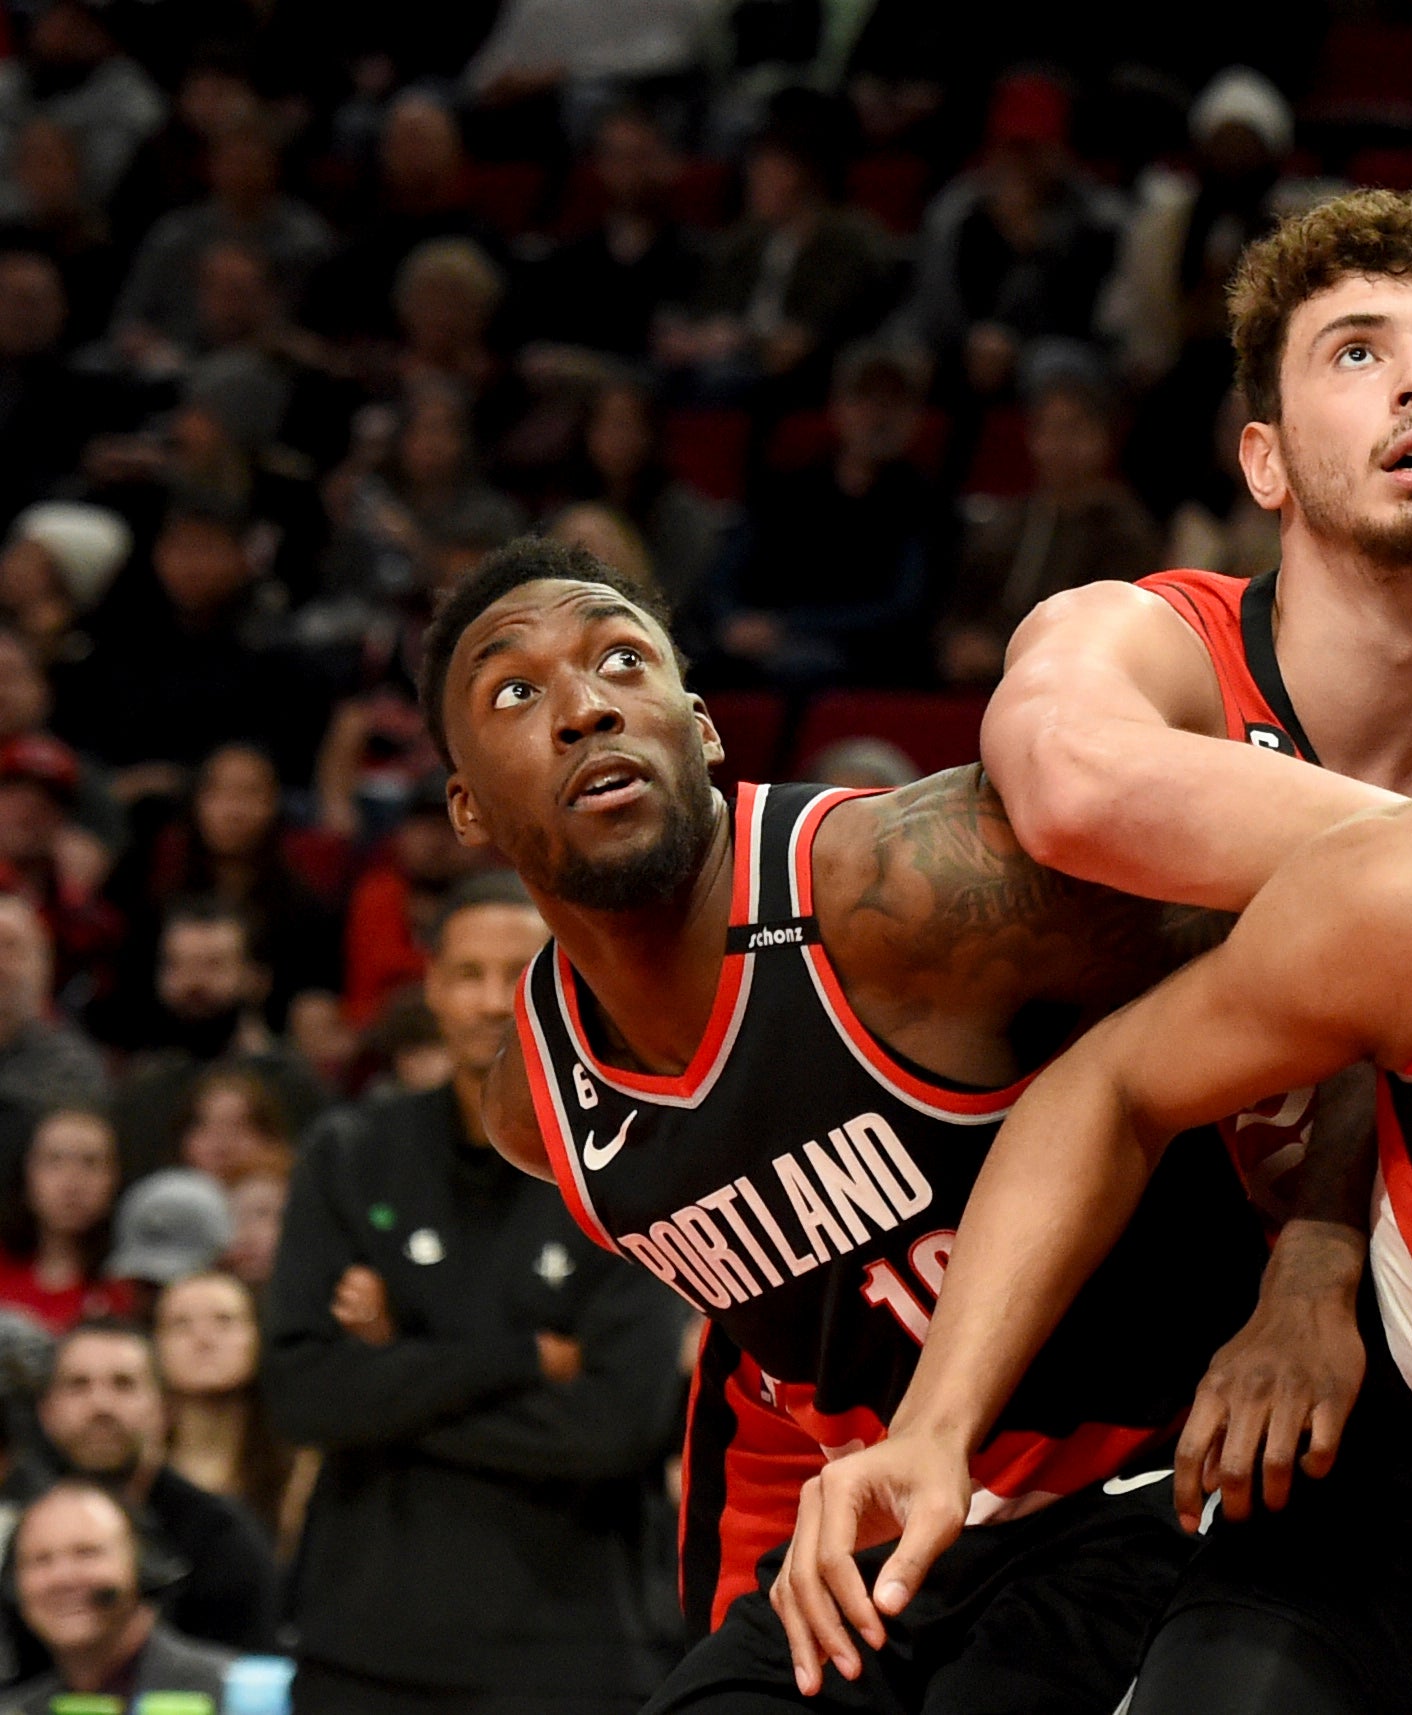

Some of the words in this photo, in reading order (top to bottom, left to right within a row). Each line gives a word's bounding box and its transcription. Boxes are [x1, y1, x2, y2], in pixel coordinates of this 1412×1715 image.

[747, 925, 804, 949] schonz
[571, 1062, 599, 1110] 6
[616, 1111, 934, 1314] PORTLAND
